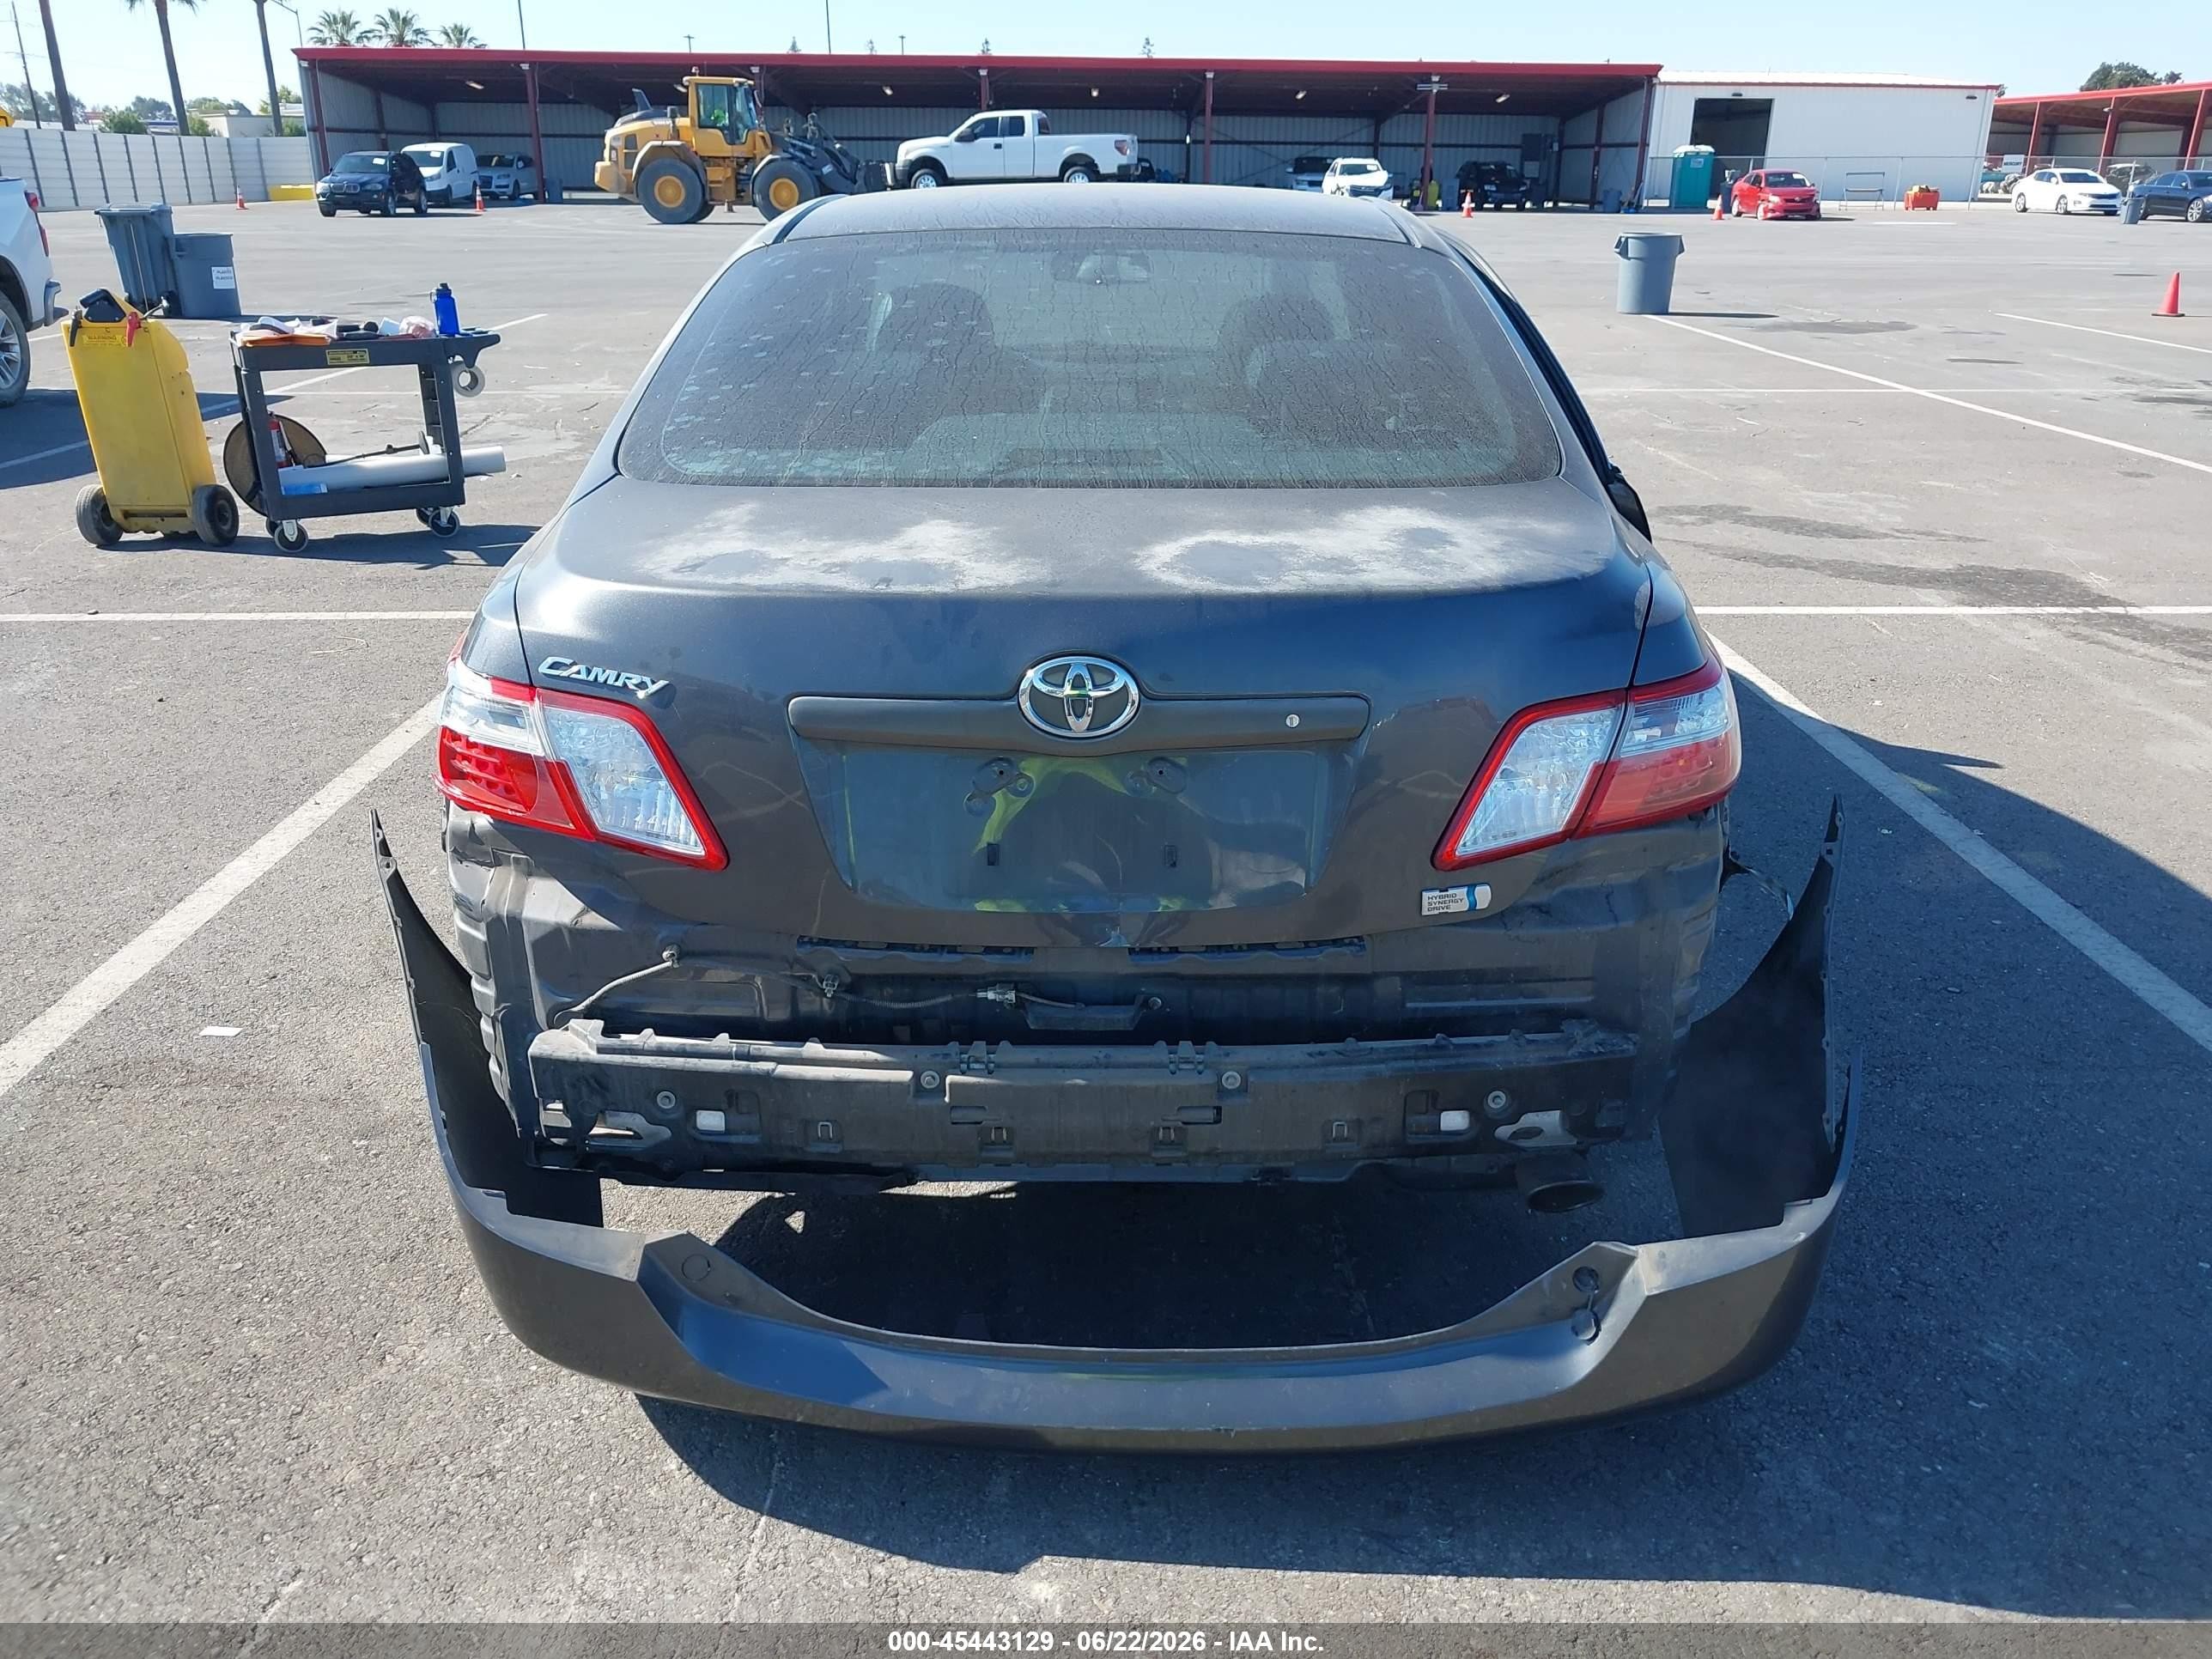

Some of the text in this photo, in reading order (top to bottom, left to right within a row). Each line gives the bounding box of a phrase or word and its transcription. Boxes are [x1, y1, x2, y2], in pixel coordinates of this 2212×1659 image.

[538, 656, 670, 700] CAMRY
[1427, 892, 1457, 901] HYBRID
[1427, 897, 1464, 907] SYNERGY
